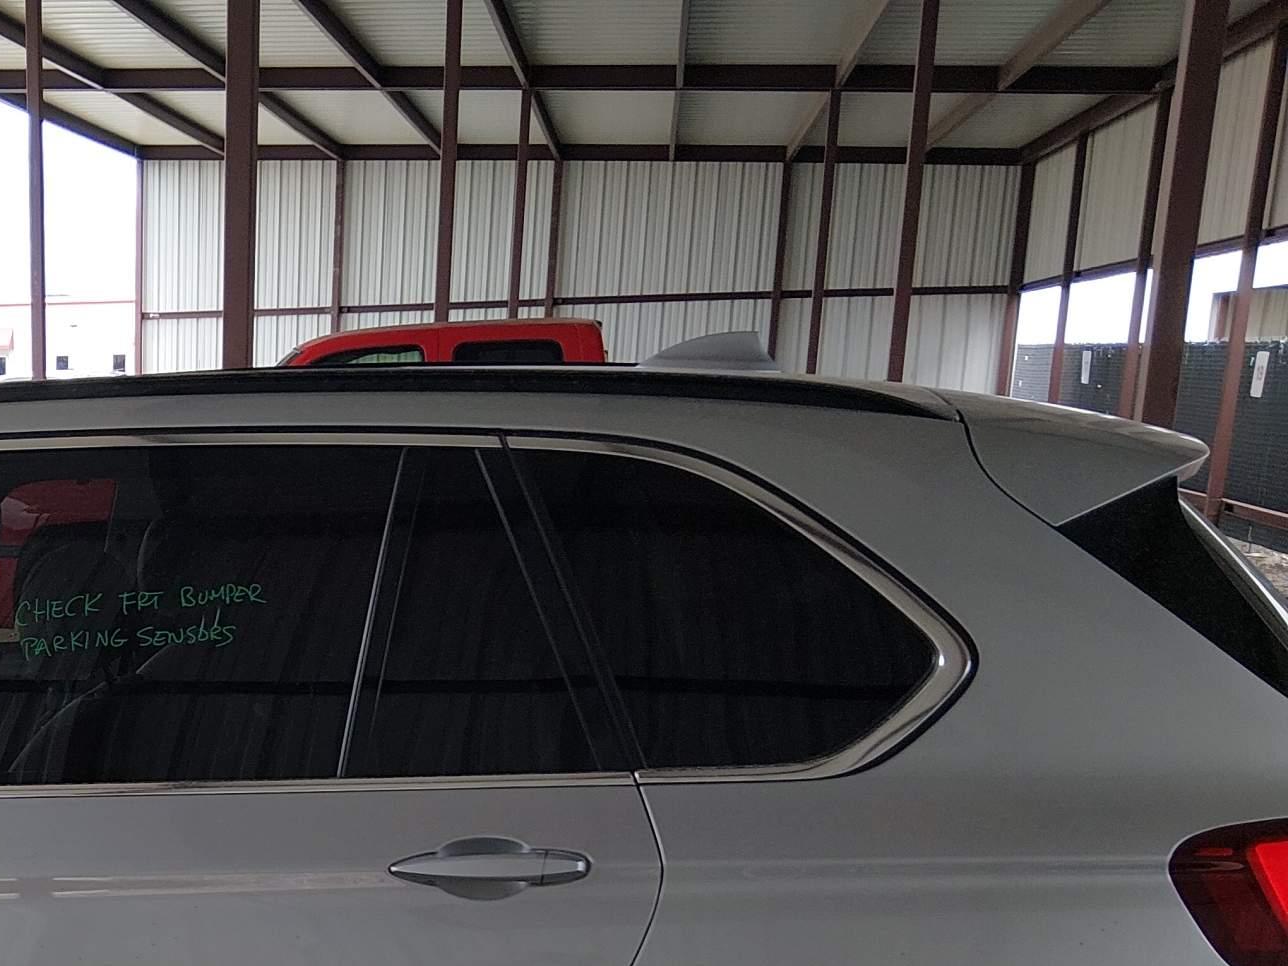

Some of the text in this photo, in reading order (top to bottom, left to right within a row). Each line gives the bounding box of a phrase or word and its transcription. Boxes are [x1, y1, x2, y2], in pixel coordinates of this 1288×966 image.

[14, 583, 267, 627] CHECK FRT BUMPER
[20, 627, 129, 661] PARKING
